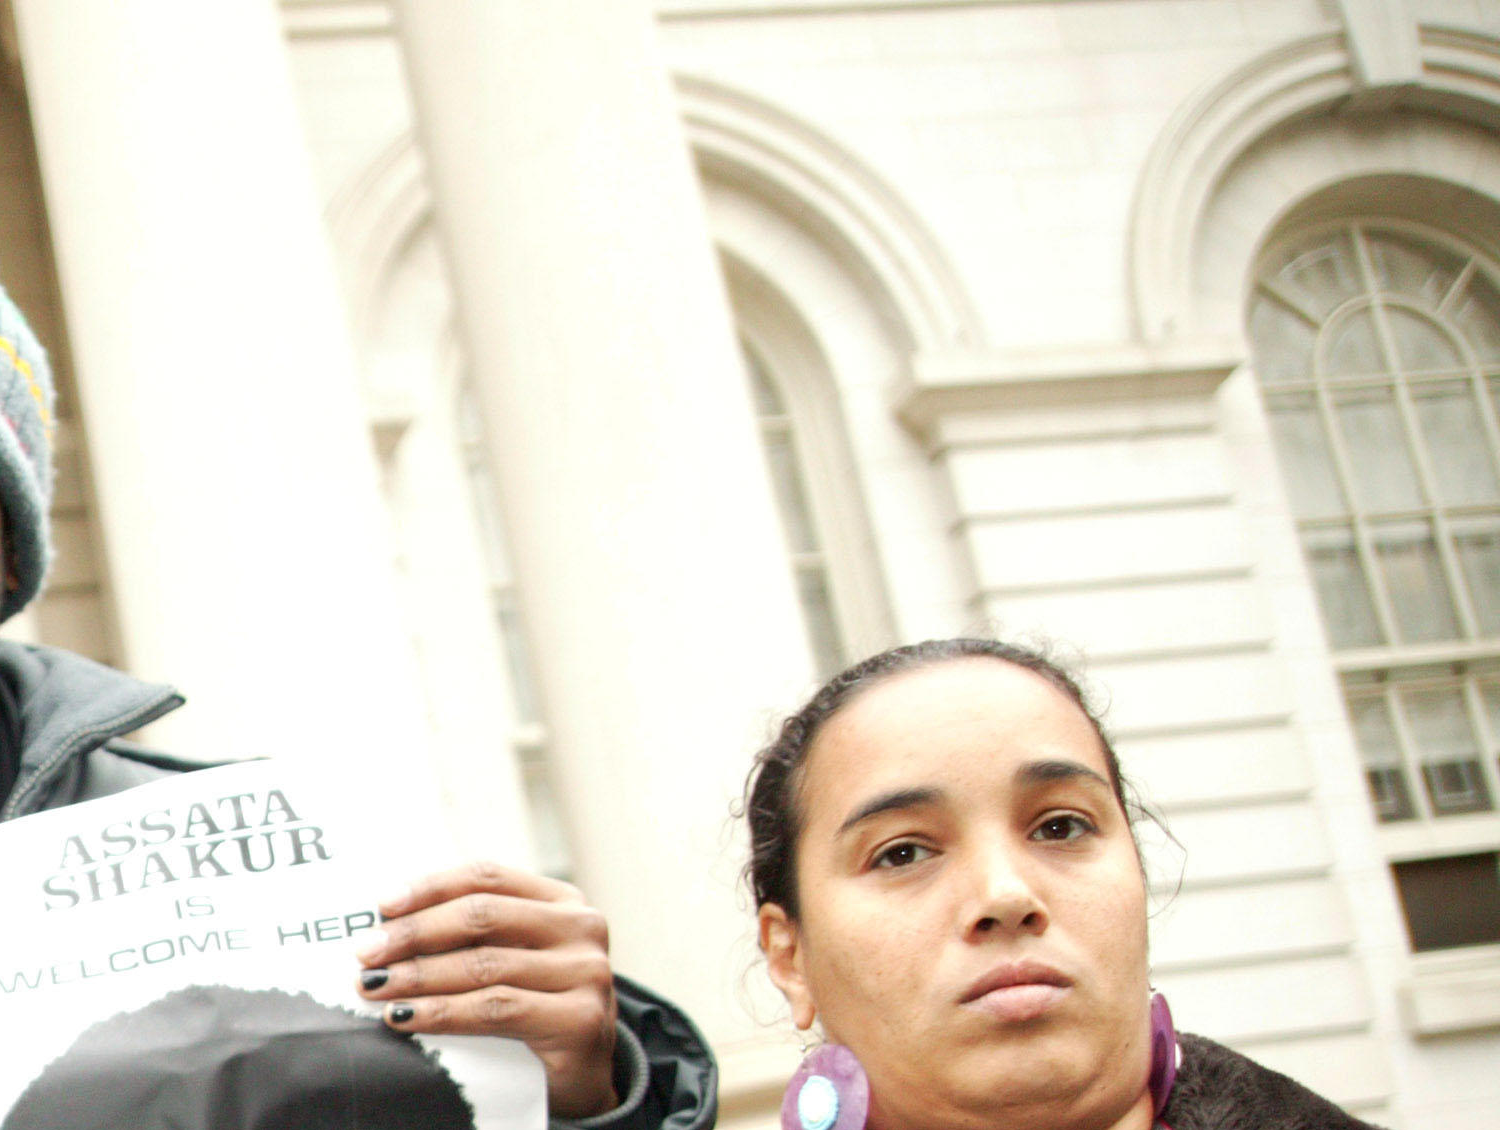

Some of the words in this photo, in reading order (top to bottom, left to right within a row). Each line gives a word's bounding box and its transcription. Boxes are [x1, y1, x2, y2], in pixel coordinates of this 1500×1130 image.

[60, 789, 303, 869] ASSATA
[42, 826, 332, 911] SHAKUR
[175, 896, 215, 920] IS
[278, 911, 392, 946] HER
